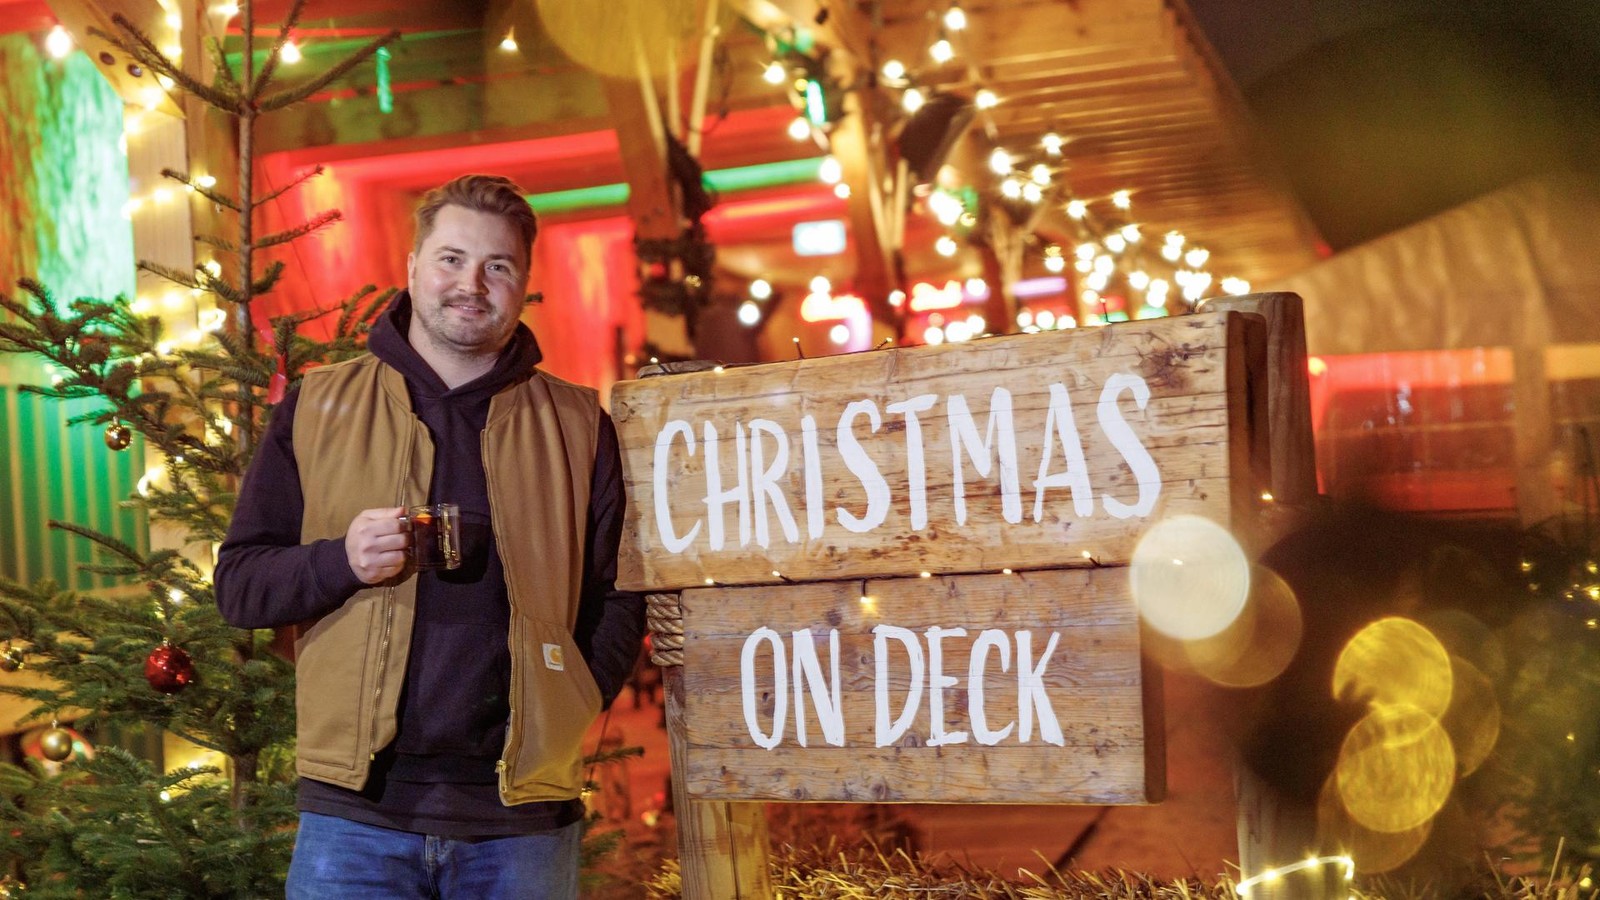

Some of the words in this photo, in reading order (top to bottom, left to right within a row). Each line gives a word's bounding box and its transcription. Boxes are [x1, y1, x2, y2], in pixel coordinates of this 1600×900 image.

[652, 372, 1163, 554] CHRISTMAS
[741, 627, 844, 750] ON
[872, 624, 1065, 749] DECK
